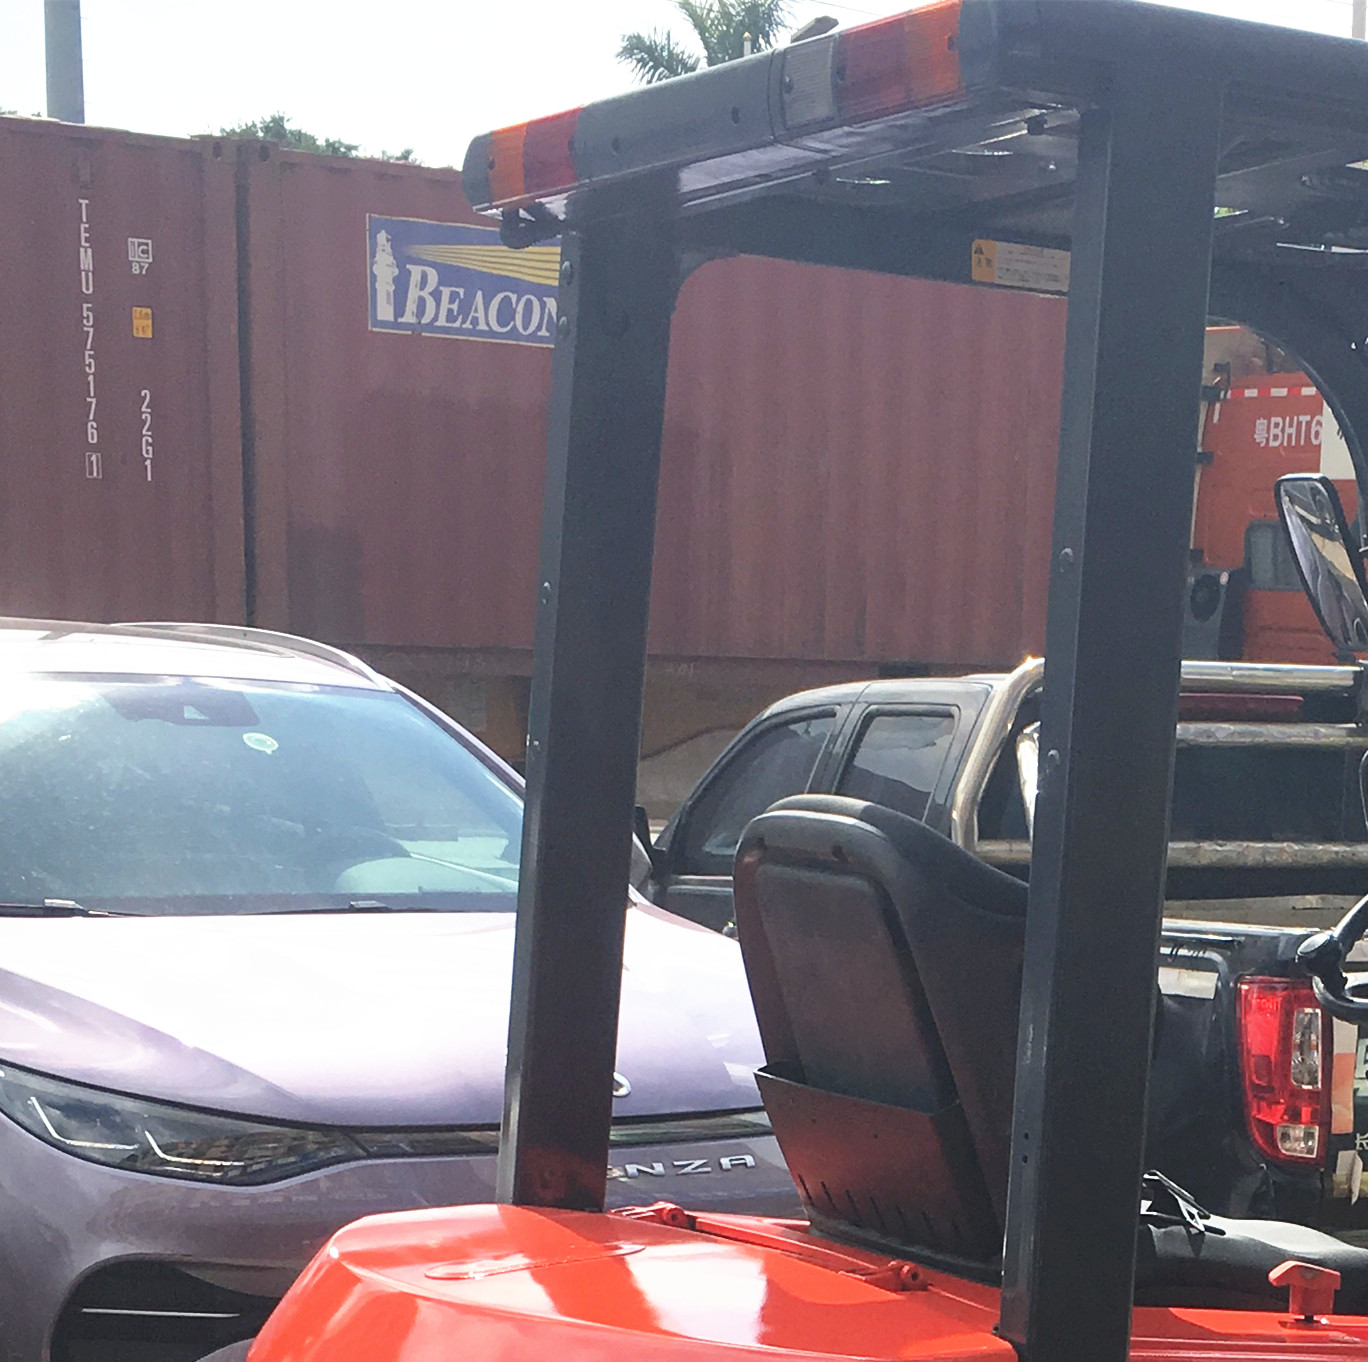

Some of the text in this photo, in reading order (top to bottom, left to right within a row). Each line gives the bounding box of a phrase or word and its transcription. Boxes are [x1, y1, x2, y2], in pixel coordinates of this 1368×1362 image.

[78, 198, 93, 294] TEMU
[131, 262, 149, 274] 87
[82, 303, 98, 443] 575176
[141, 389, 153, 481] 22G1
